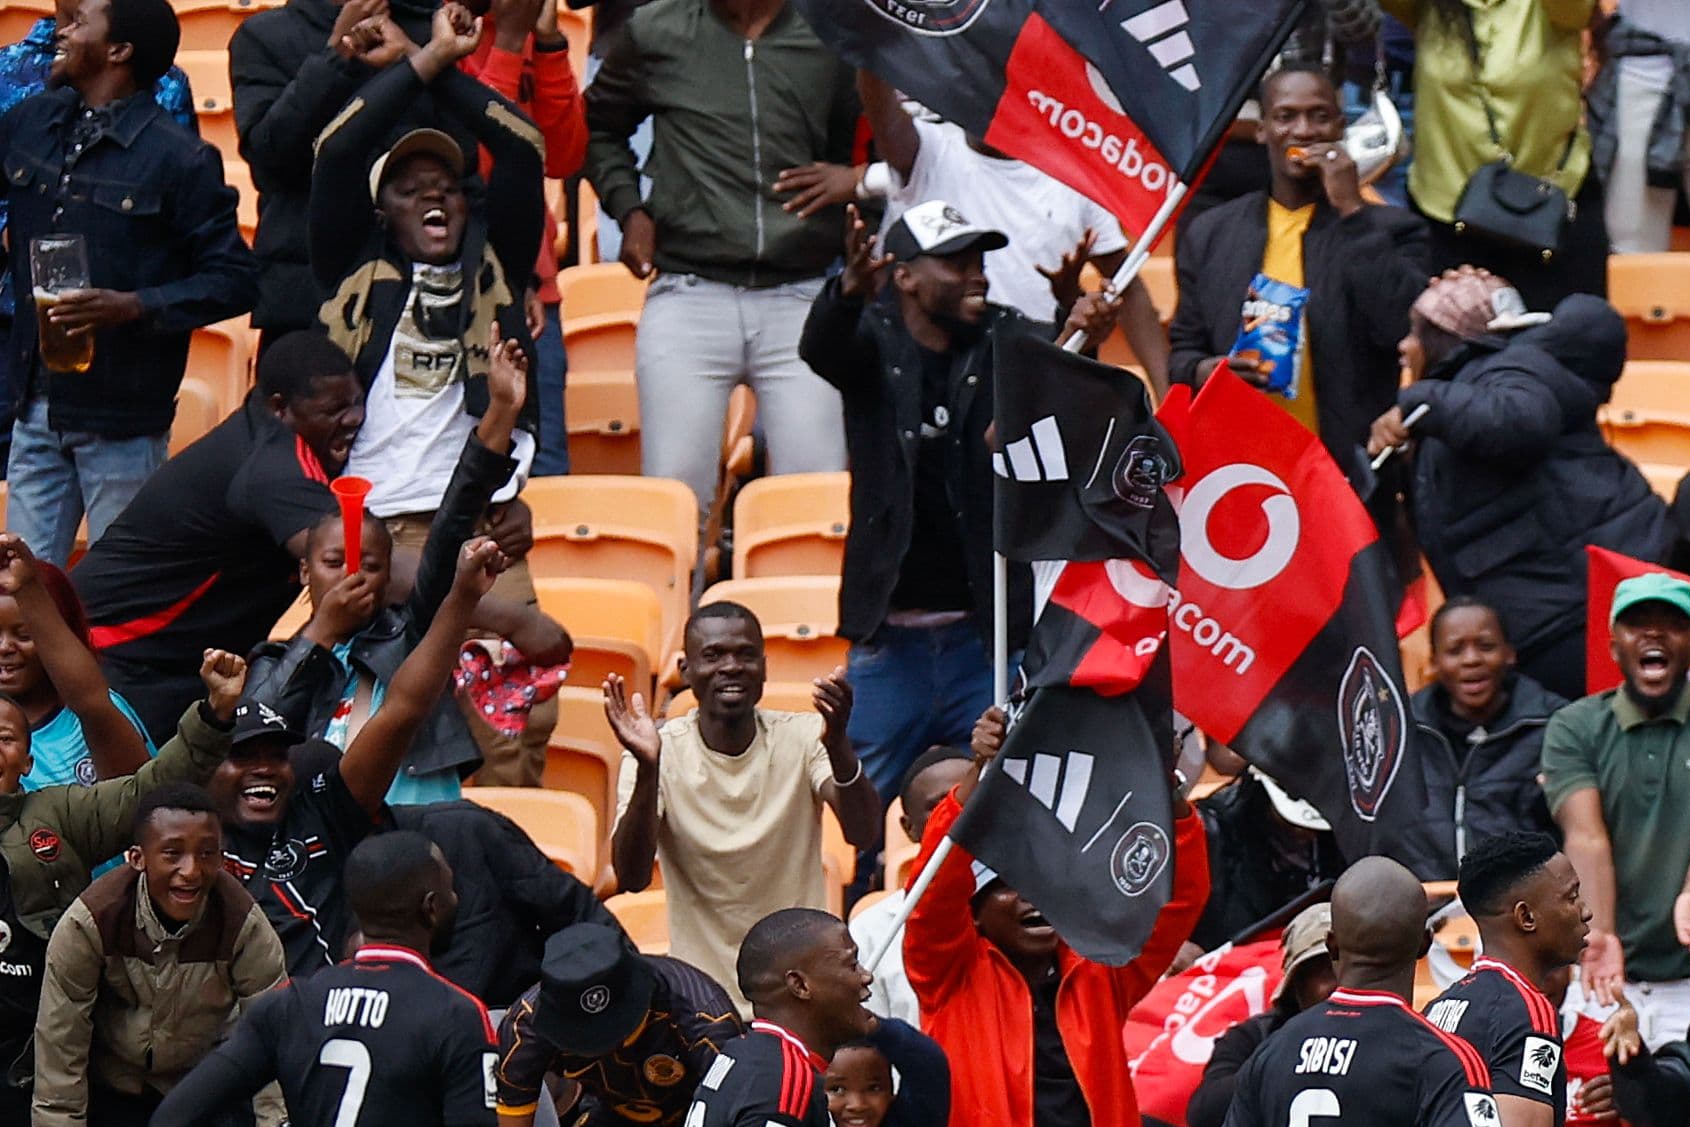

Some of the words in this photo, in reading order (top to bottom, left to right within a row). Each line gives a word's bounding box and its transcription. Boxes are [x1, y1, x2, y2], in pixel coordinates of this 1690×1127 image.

[1165, 586, 1257, 676] acom
[324, 987, 389, 1028] HOTTO
[1295, 1037, 1358, 1076] SIBISI
